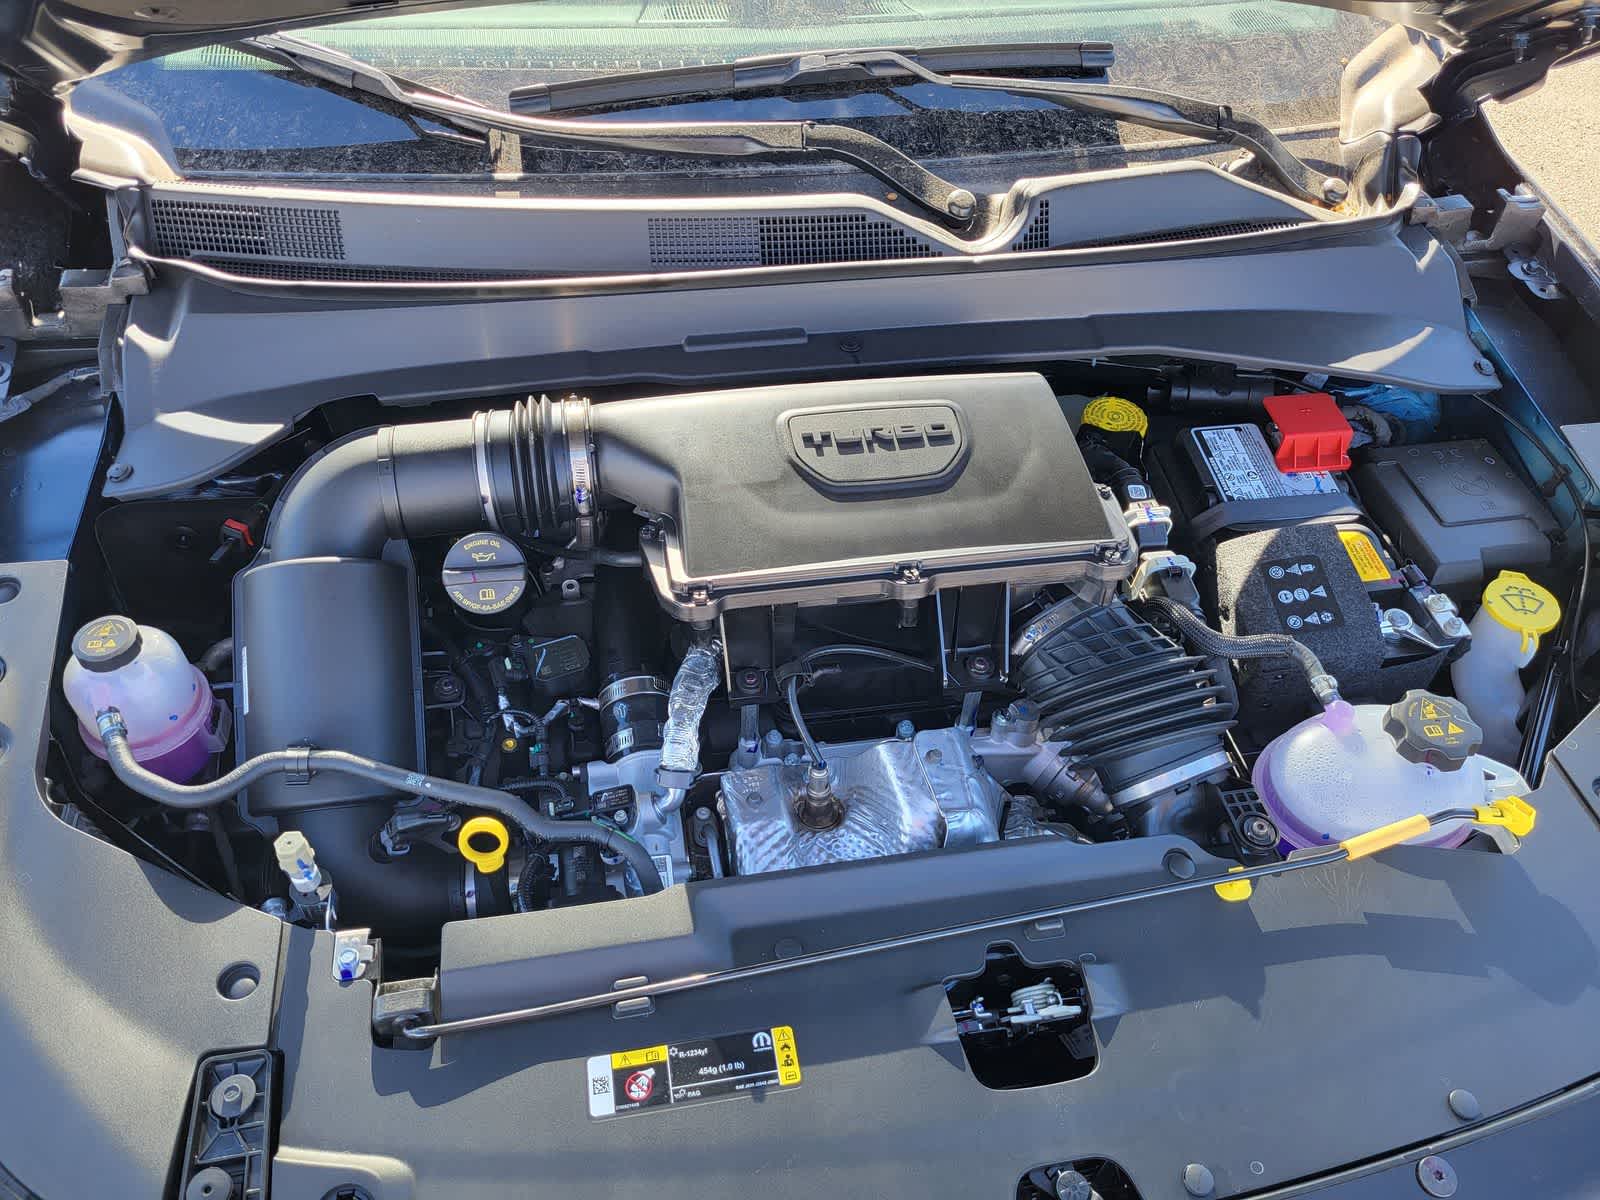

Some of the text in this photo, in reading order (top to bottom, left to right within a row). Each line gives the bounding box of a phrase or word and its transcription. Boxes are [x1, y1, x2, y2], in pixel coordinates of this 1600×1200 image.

[464, 540, 500, 550] ENGINE OIL
[679, 1048, 708, 1058] R-1234yf
[698, 1061, 745, 1075] 454g (1.0 lb)
